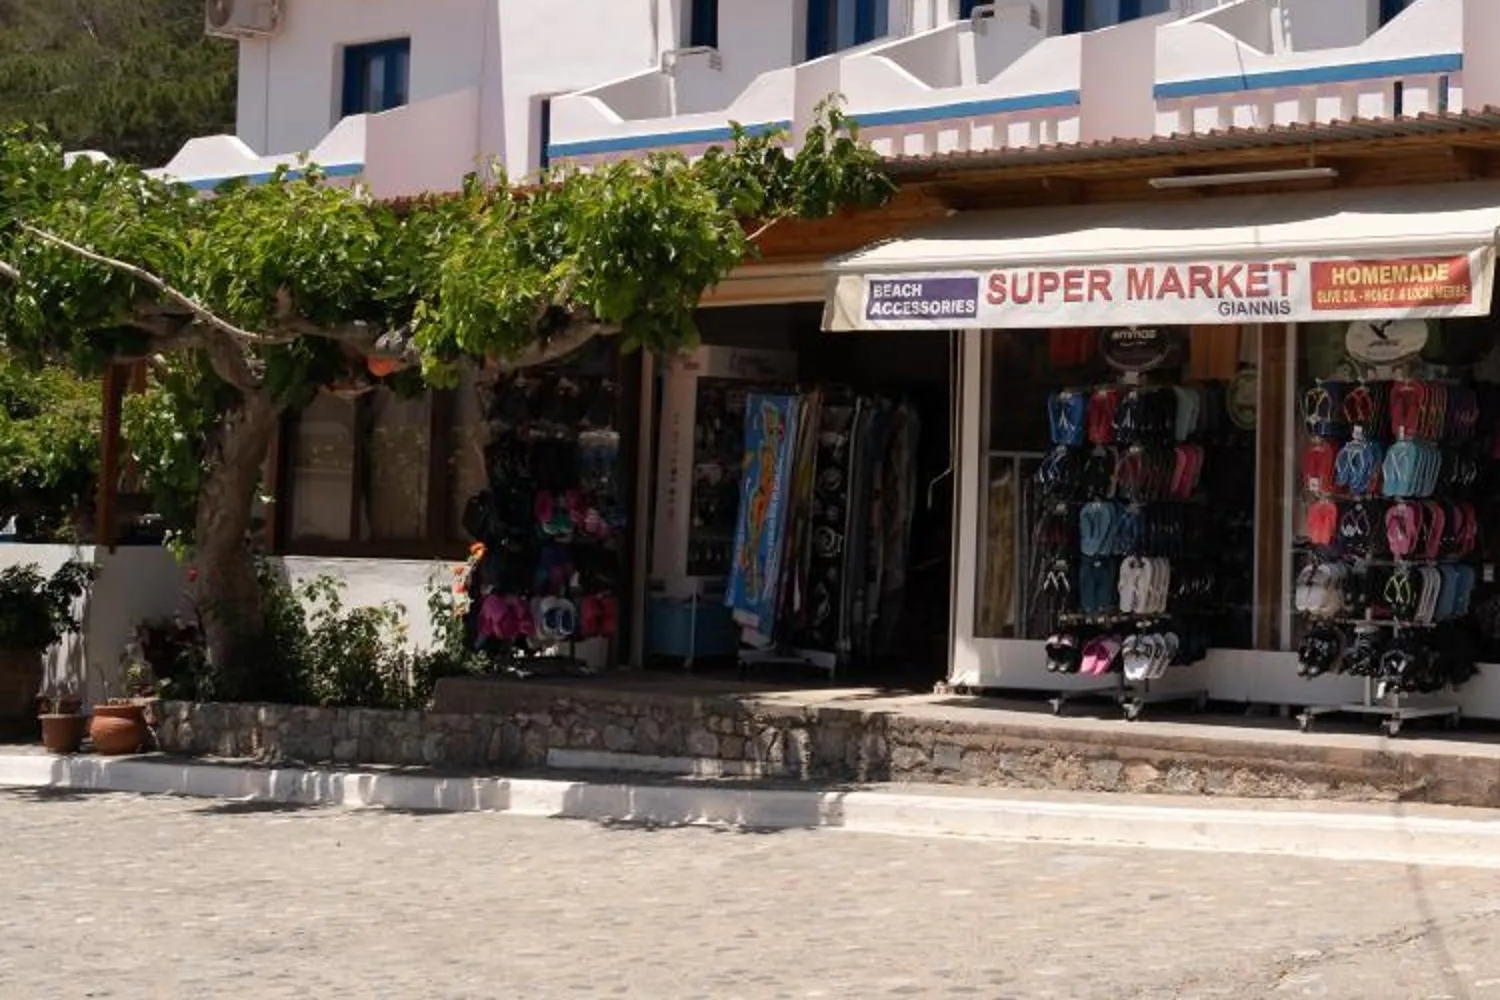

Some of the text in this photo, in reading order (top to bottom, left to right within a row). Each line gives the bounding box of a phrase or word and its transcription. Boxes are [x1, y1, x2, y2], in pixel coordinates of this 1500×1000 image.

[1332, 264, 1449, 285] HOMEMADE
[873, 283, 922, 298] BEACH
[987, 262, 1296, 305] SUPER MARKET
[870, 299, 975, 315] ACCESSORIES
[1217, 300, 1291, 317] GIANNIS
